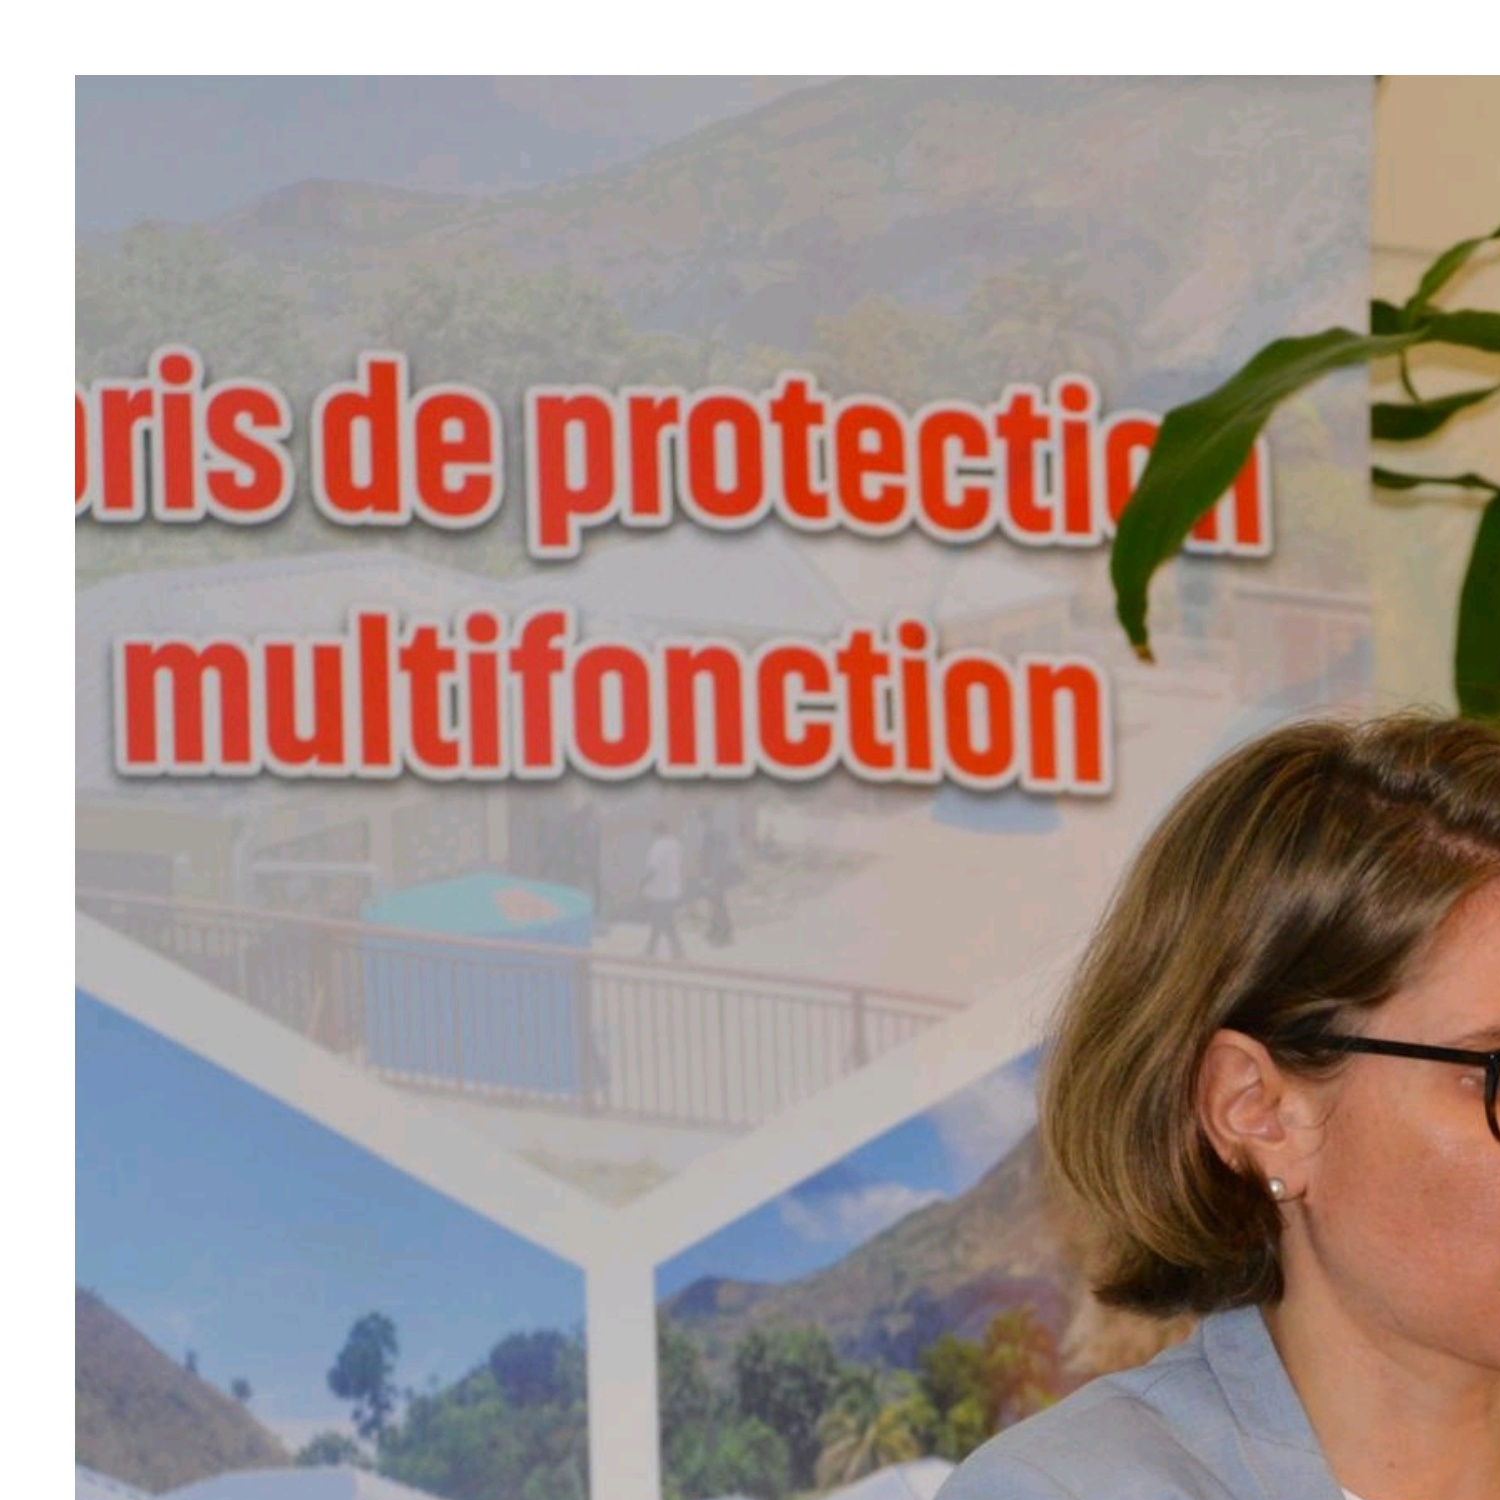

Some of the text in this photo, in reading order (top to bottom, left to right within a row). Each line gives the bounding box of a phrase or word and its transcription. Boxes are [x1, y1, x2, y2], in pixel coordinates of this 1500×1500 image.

[75, 352, 286, 514] ris
[320, 359, 494, 519] de
[123, 610, 1104, 786] multifonction
